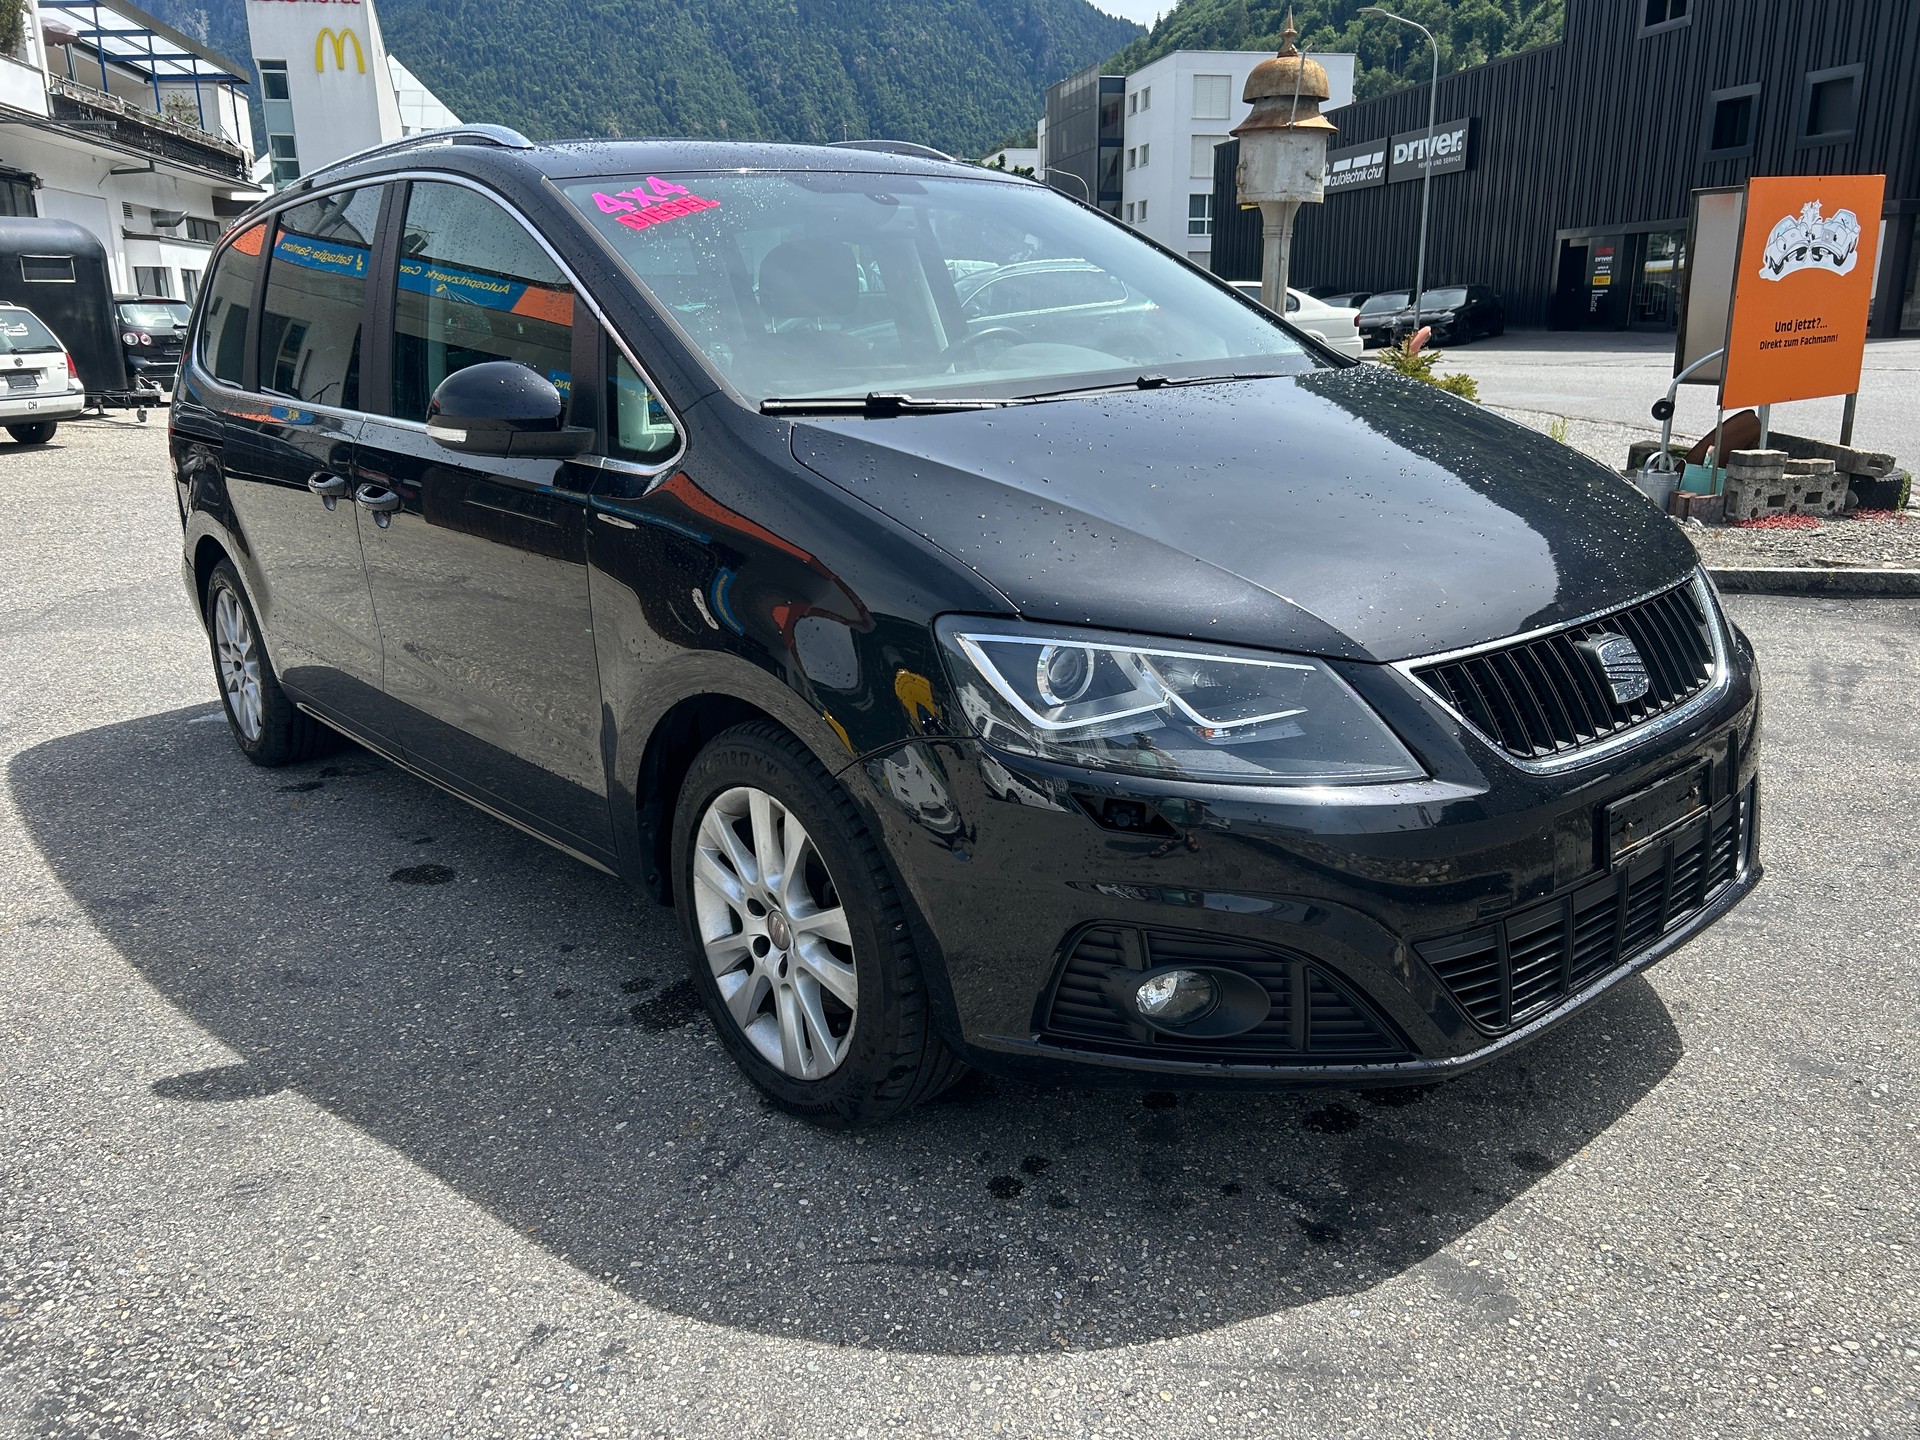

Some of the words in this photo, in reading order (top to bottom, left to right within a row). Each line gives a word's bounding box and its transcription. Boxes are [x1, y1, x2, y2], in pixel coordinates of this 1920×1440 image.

[1418, 161, 1433, 169] REIFN
[1433, 158, 1442, 167] UND
[1443, 154, 1462, 164] SERVICE
[1330, 168, 1368, 187] autotechnik
[1367, 166, 1384, 180] chur
[615, 195, 721, 231] DIESEL
[1774, 320, 1793, 333] Und
[1794, 317, 1828, 333] jetzt?...
[1759, 339, 1782, 350] Direkt
[1783, 338, 1799, 348] zum
[1800, 334, 1839, 346] Fachmann!
[27, 401, 38, 410] CH
